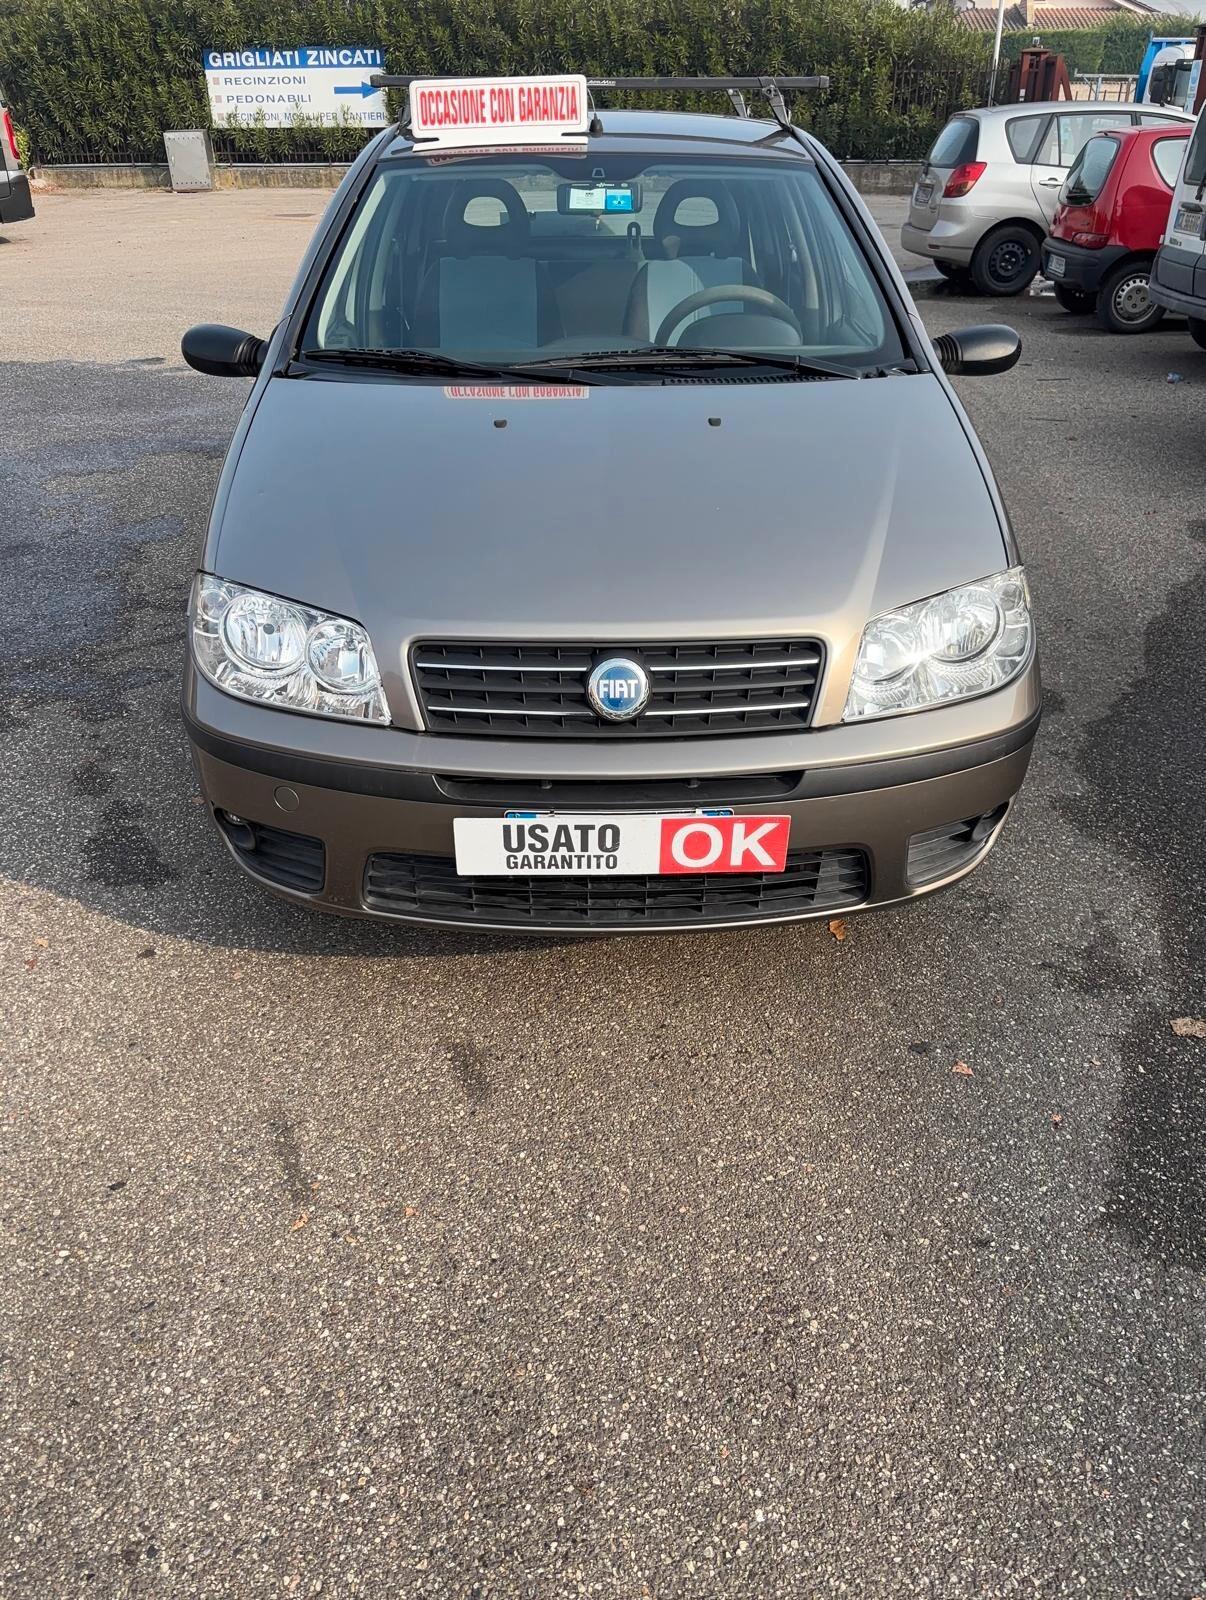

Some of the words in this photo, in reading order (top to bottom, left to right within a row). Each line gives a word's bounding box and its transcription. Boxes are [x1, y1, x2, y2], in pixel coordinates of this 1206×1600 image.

[208, 51, 300, 67] GRIGLIATI
[306, 50, 381, 65] ZINCATI
[224, 76, 306, 86] RECINZIONI
[226, 94, 312, 104] PEDONABILI
[419, 88, 487, 126] OCCASIONE
[490, 87, 515, 123] CON
[518, 86, 578, 122] GARANZIA
[599, 679, 639, 699] FIAT
[502, 823, 621, 853] USATO
[671, 822, 781, 868] OK
[505, 854, 618, 870] GARANTITO
